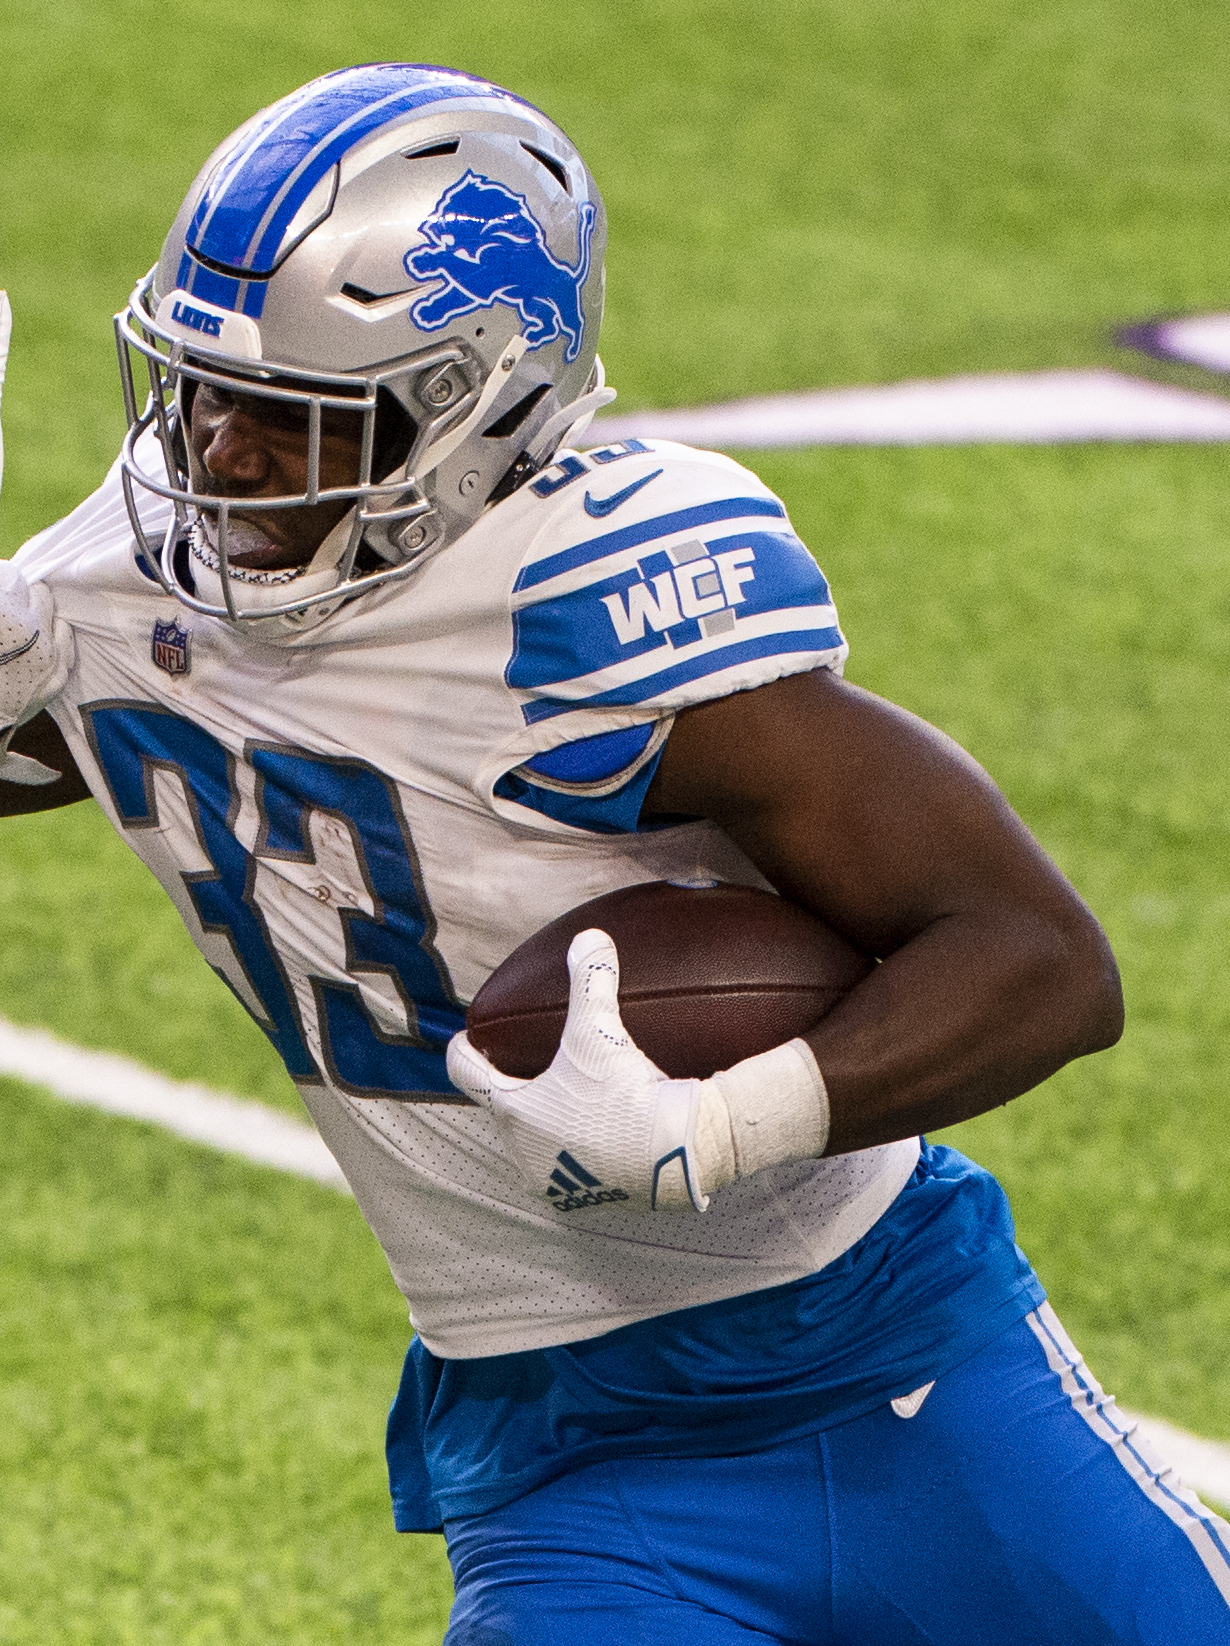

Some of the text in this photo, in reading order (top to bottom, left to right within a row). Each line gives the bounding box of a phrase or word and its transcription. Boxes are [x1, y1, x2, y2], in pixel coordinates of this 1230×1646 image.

[599, 547, 755, 645] WCF
[157, 643, 185, 673] NFL
[78, 697, 482, 1106] 33
[552, 1188, 629, 1211] adidas
